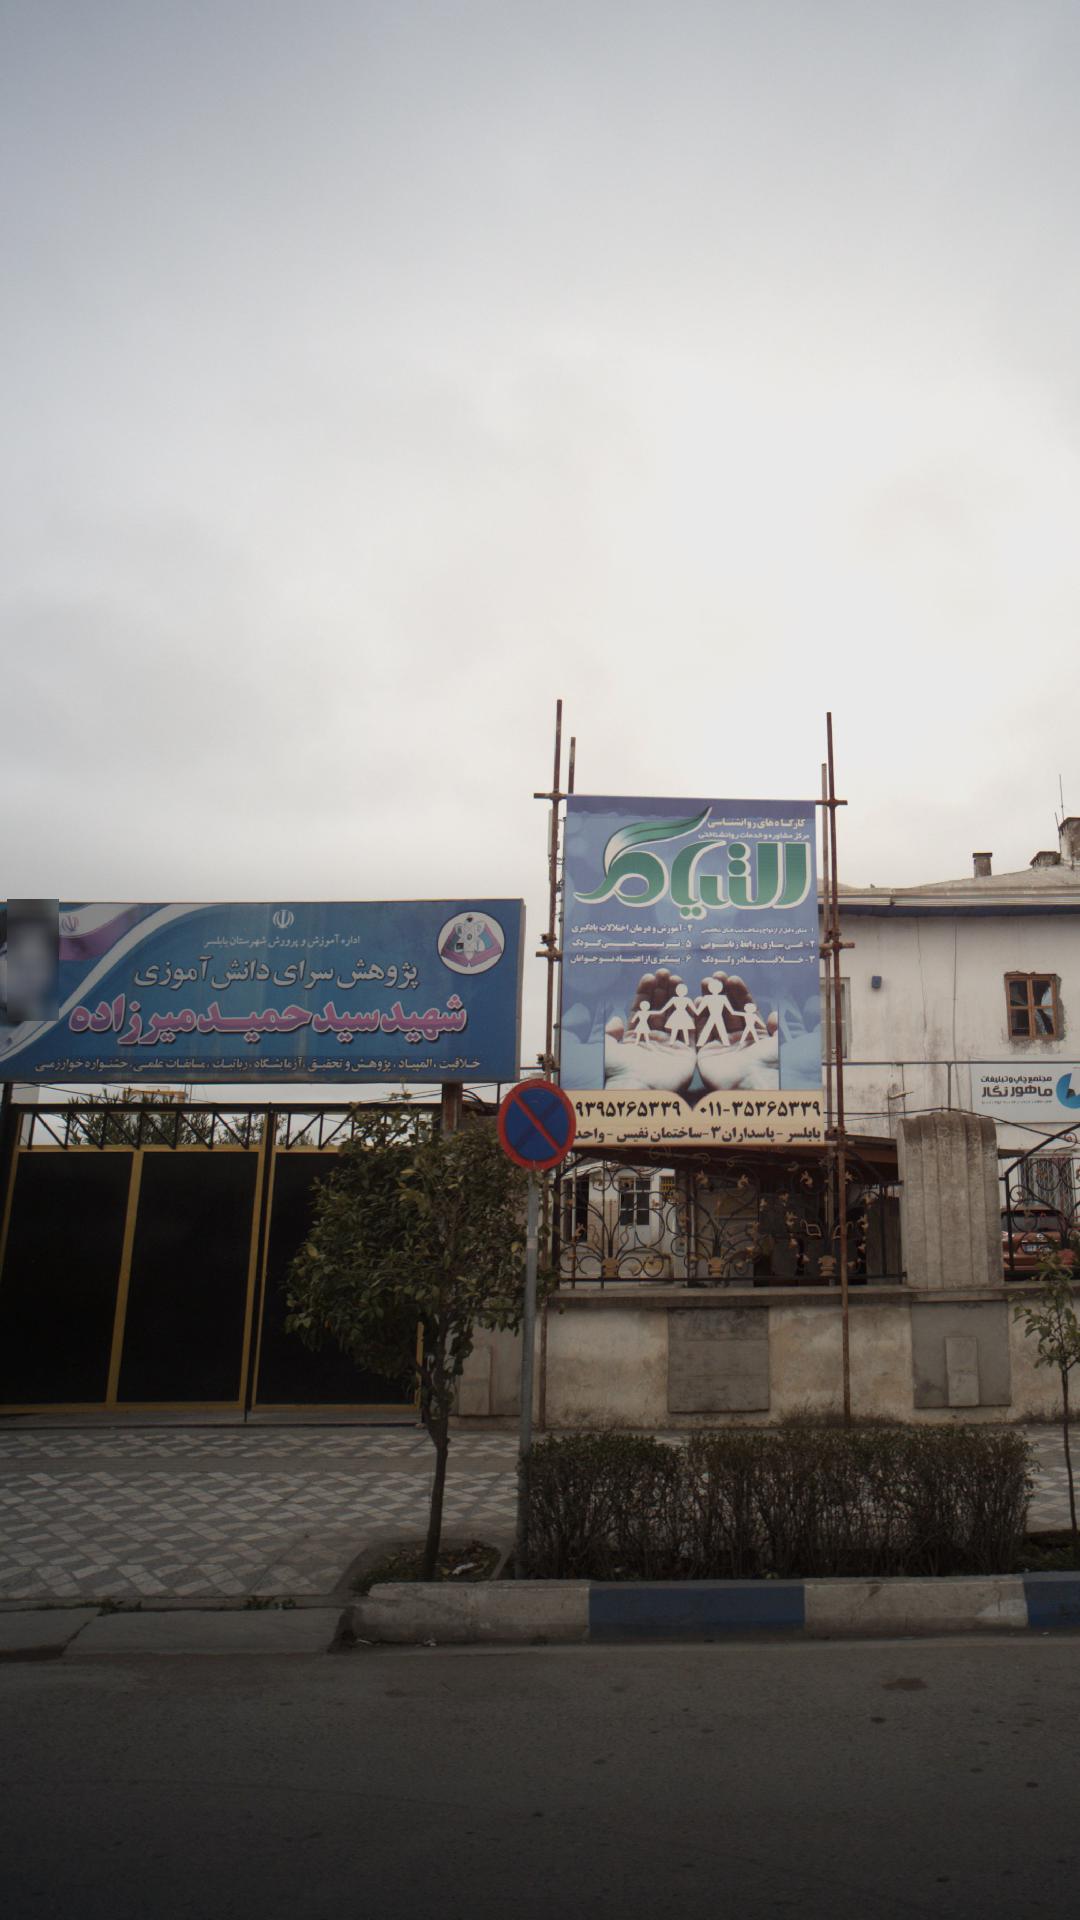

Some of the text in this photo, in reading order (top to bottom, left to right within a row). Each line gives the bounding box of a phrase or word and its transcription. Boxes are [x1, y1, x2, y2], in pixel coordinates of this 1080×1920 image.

[708, 817, 756, 829] روانشناسی
[203, 935, 229, 949] بابلسر
[230, 935, 267, 949] شهرستان
[268, 936, 299, 949] پرورش
[307, 933, 340, 949] آموزش
[341, 935, 361, 947] اداره
[134, 954, 420, 990] پژوهش سرای دانش آموزی
[68, 993, 468, 1046] شهید سید حمید میرزاده
[35, 1057, 83, 1073] خوارزمی
[84, 1057, 129, 1072] جشنواره
[351, 1057, 392, 1073] پژوهش
[982, 1084, 1053, 1098] ماهور نگار
[575, 1100, 681, 1117] ۹۳۹۵۲۶۵۳۳۹
[574, 1127, 605, 1144] واحد
[616, 1126, 649, 1143] نفیس
[650, 1126, 702, 1143] ساختمان
[721, 1126, 775, 1143] پاسداران
[786, 1126, 821, 1143] بابلسر
